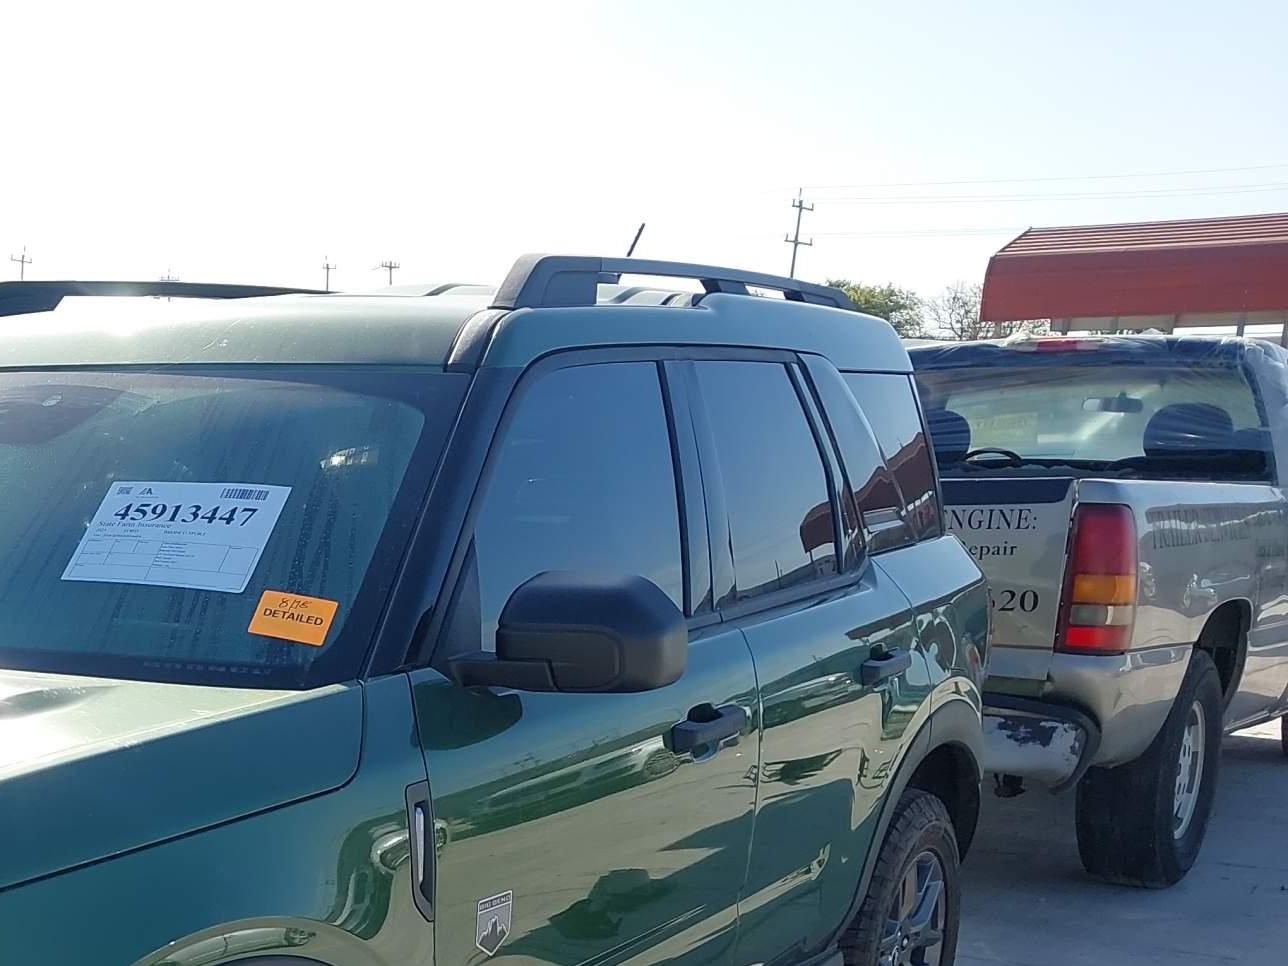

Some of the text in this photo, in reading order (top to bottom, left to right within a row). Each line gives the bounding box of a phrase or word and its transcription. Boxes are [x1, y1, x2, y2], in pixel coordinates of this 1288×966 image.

[114, 503, 259, 527] 45913447
[137, 521, 173, 529] Insurance
[944, 508, 1038, 530] NGINE:
[961, 540, 1018, 561] epair
[991, 589, 1040, 613] 20
[263, 607, 324, 627] DETAILED
